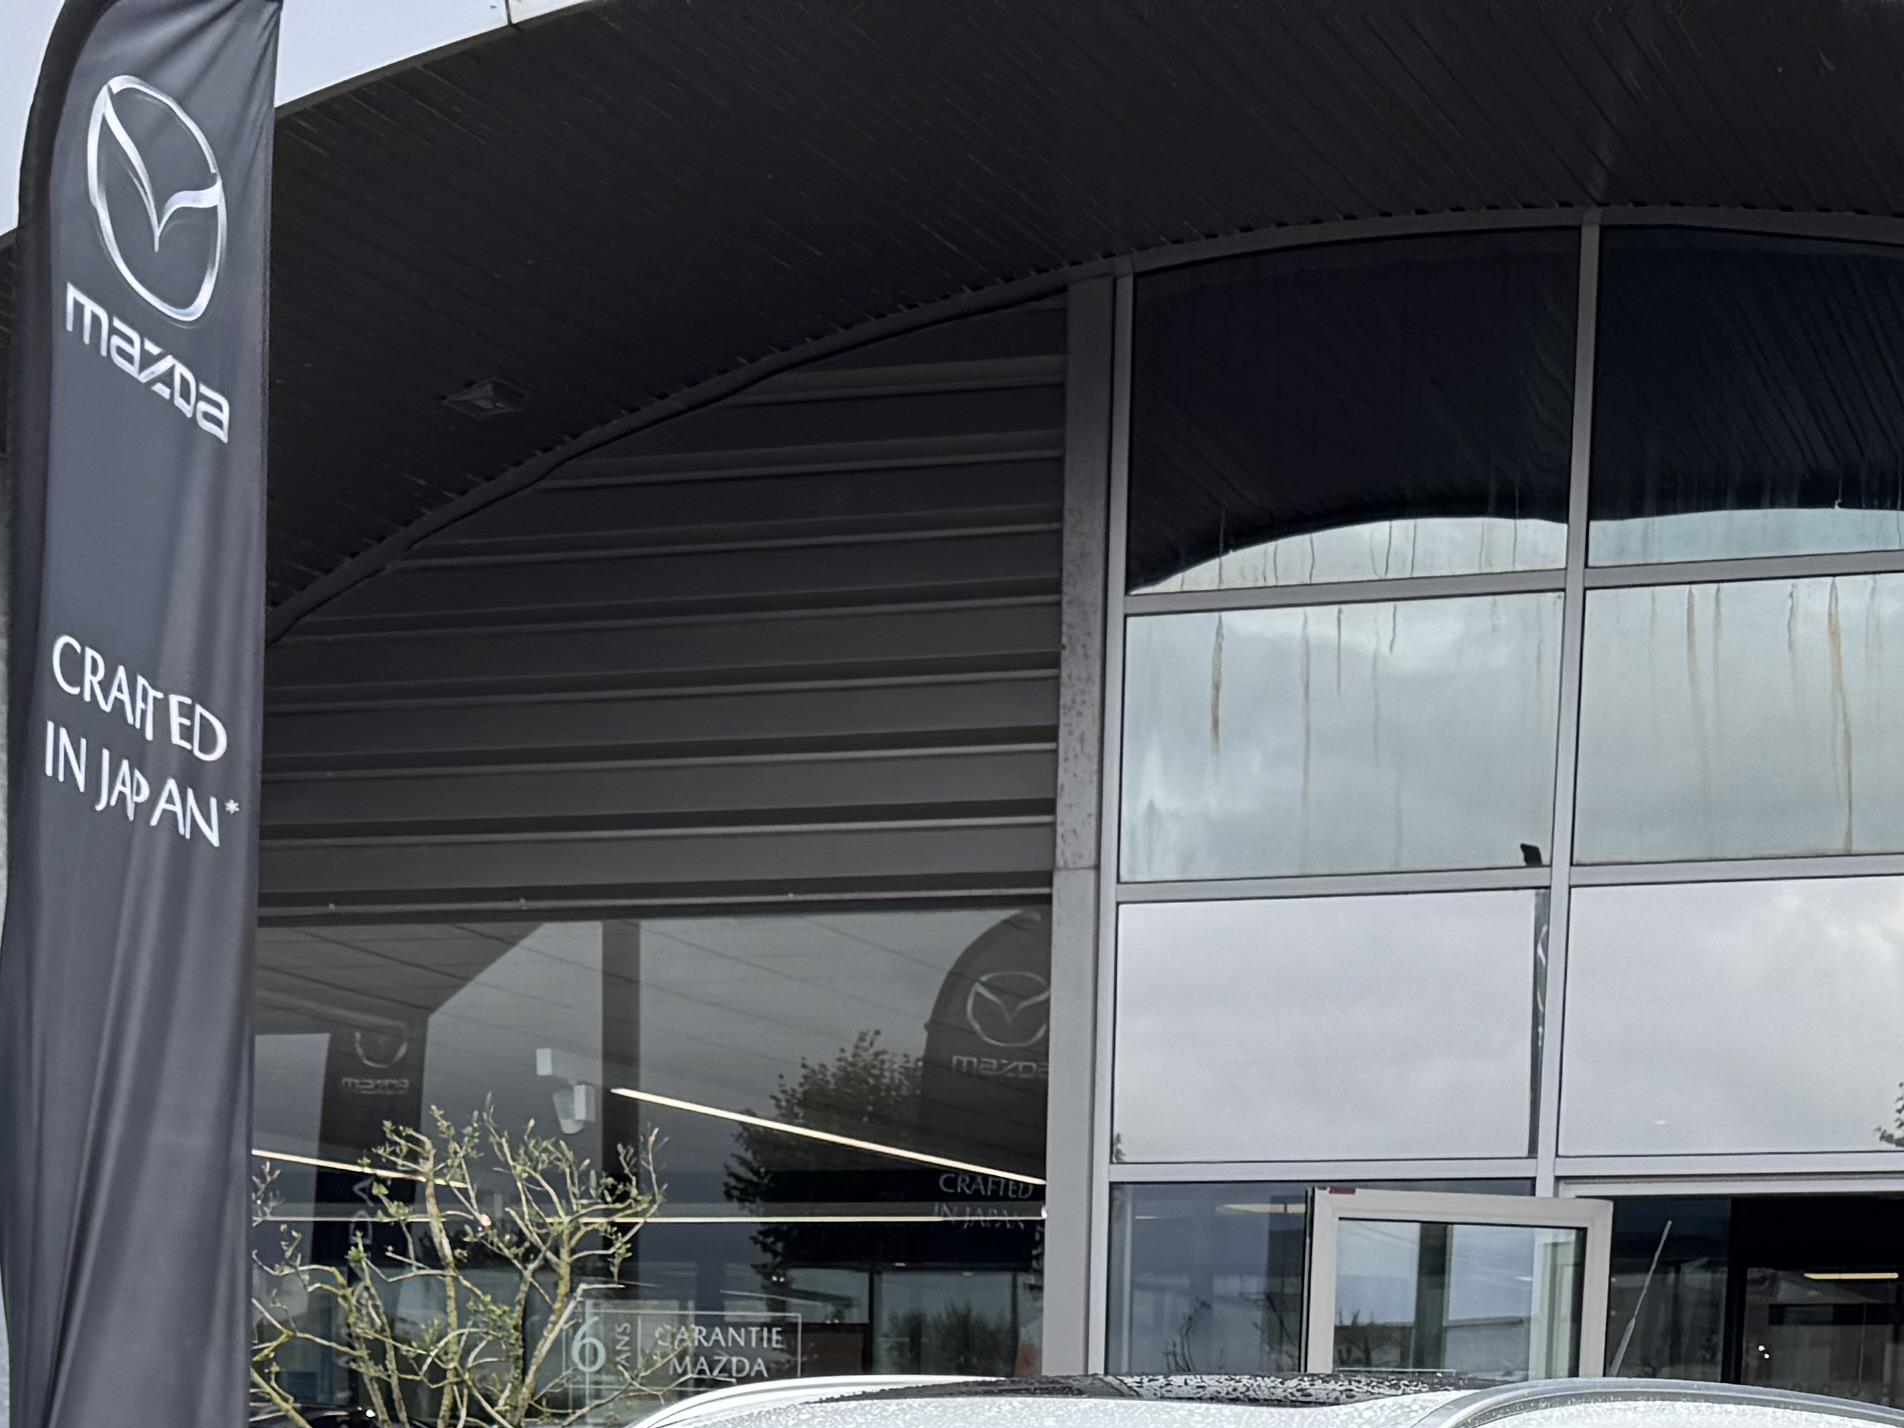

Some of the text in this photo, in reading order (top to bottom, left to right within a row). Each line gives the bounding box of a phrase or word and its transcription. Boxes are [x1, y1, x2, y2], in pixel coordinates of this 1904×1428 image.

[52, 634, 228, 762] CRAFTED
[45, 720, 87, 793] IN
[571, 1316, 632, 1373] 6 ANS
[669, 1353, 769, 1379] MAZDA
